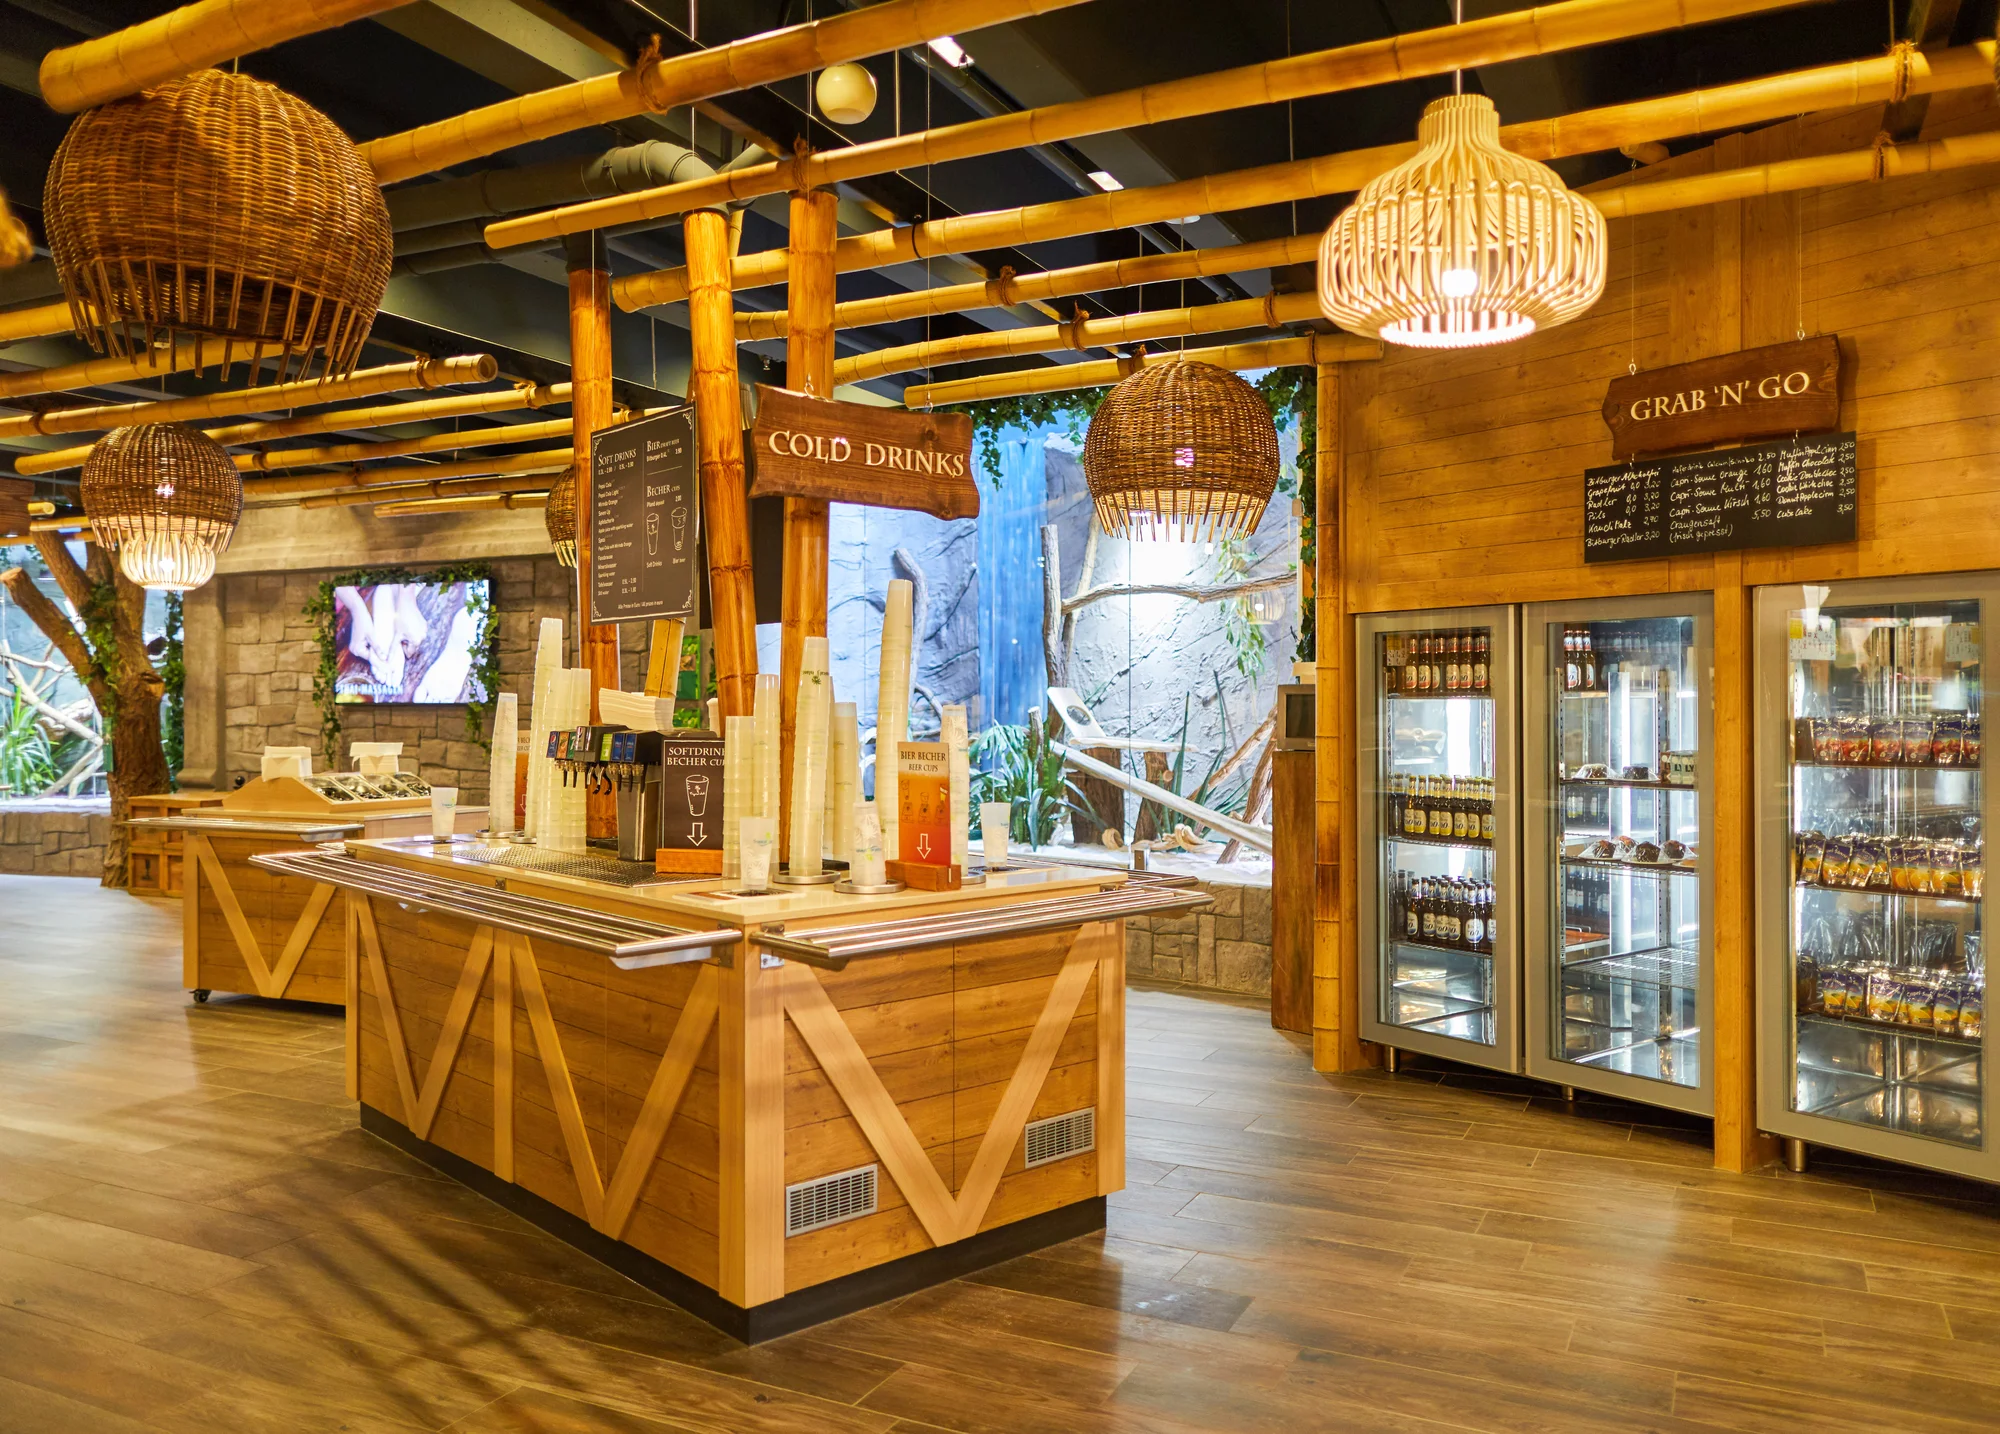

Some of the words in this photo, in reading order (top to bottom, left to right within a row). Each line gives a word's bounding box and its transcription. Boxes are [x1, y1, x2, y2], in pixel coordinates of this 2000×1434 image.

[1631, 390, 1706, 420] GRAB
[1758, 371, 1810, 398] GO
[647, 440, 660, 452] BIER
[599, 454, 613, 466] SOFT
[615, 449, 636, 462] DRINKS
[769, 430, 851, 463] COLD
[865, 443, 964, 478] DRINKS
[647, 485, 670, 497] BECHER
[1587, 498, 1617, 509] Radler
[1644, 492, 1659, 501] 3,20
[1587, 511, 1606, 521] Pils
[1644, 503, 1660, 512] 3,20
[1586, 537, 1620, 548] Bitburger
[667, 757, 707, 766] BECHER
[900, 750, 916, 760] BIER
[918, 752, 946, 761] BECHER
[923, 764, 938, 772] CUPS
